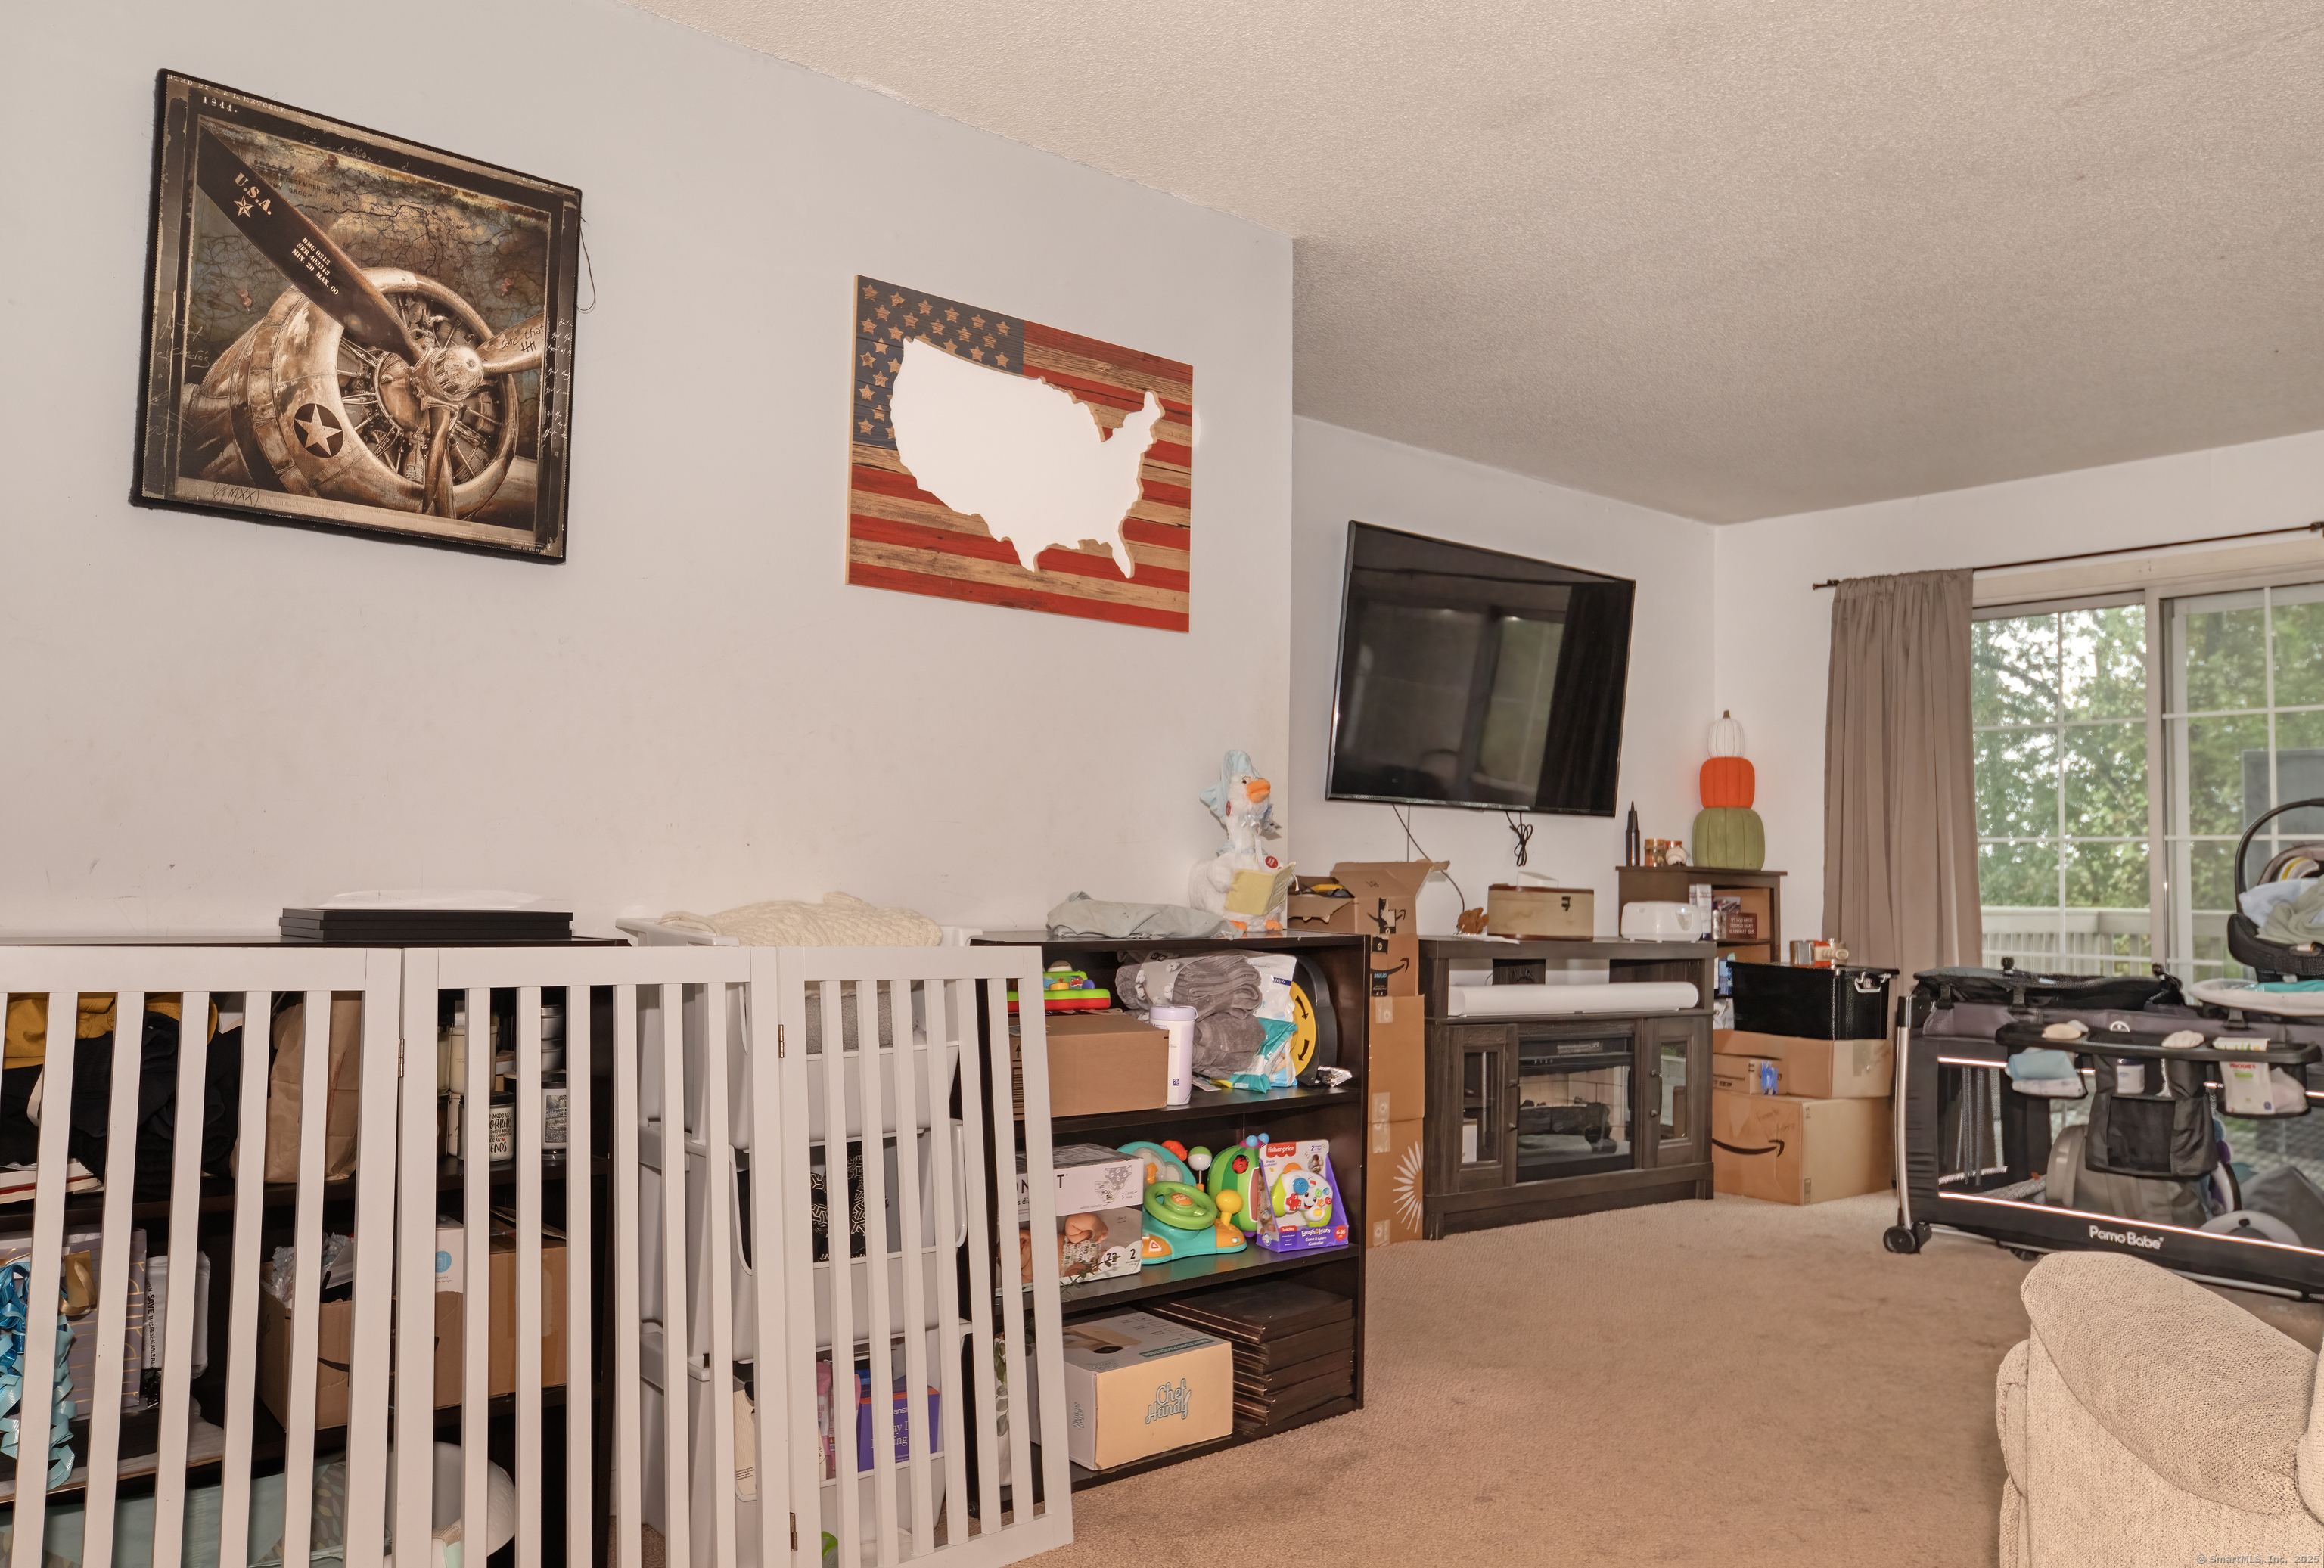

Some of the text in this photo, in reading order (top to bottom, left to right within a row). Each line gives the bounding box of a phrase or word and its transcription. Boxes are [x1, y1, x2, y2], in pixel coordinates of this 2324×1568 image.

[235, 172, 272, 216] U.S.A.
[297, 242, 331, 276] SER 403313
[302, 237, 331, 265] DMG 0313
[306, 262, 315, 272] 20
[489, 1116, 512, 1129] ORKERS
[489, 1141, 507, 1153] ENDS
[1129, 1248, 1136, 1260] 2
[1155, 1377, 1187, 1405] Chef
[1145, 1396, 1190, 1425] Handy
